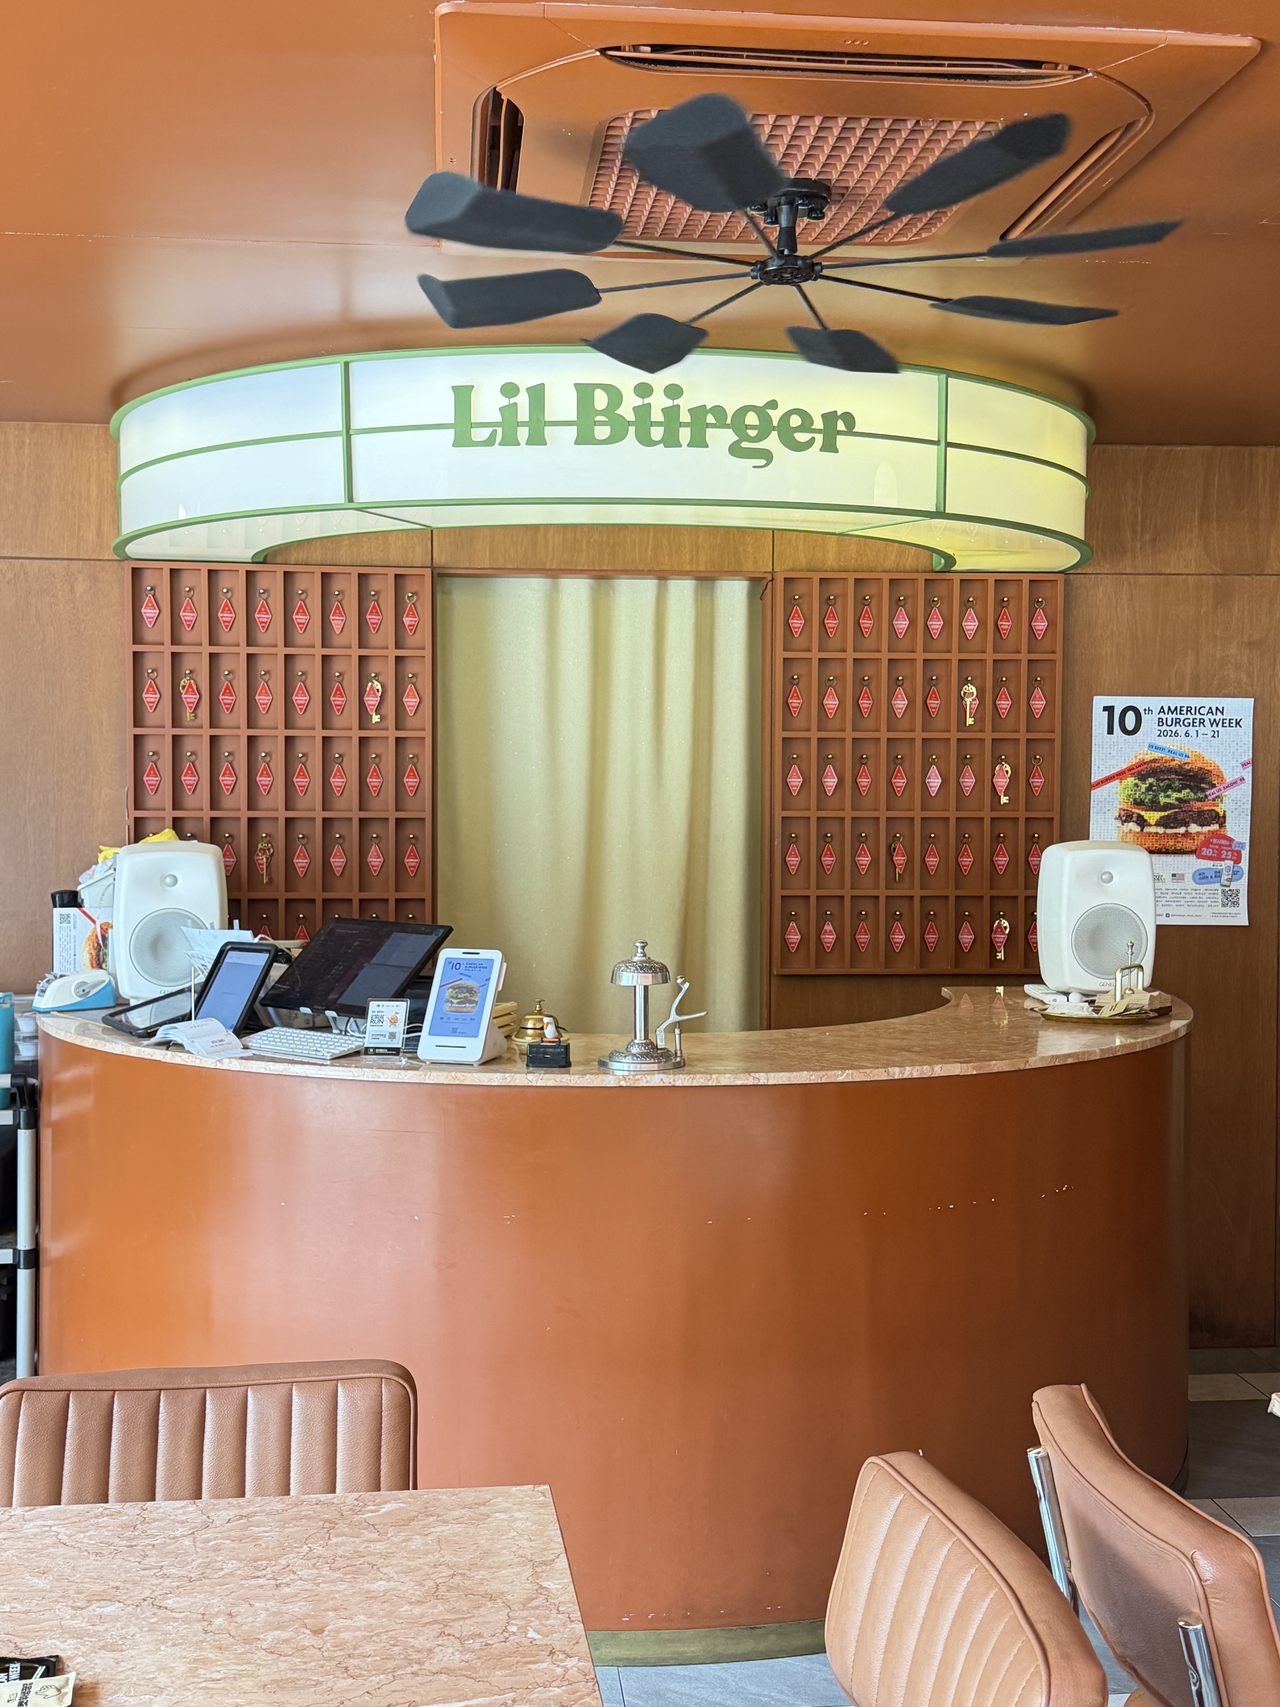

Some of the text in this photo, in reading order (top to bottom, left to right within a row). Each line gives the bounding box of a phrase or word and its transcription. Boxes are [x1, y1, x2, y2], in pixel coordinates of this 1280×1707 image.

[452, 382, 856, 468] Lil Bürger
[1102, 705, 1224, 736] 10th AMERICAN
[1157, 718, 1242, 728] BURGER WEEK
[1157, 730, 1182, 738] 2026.
